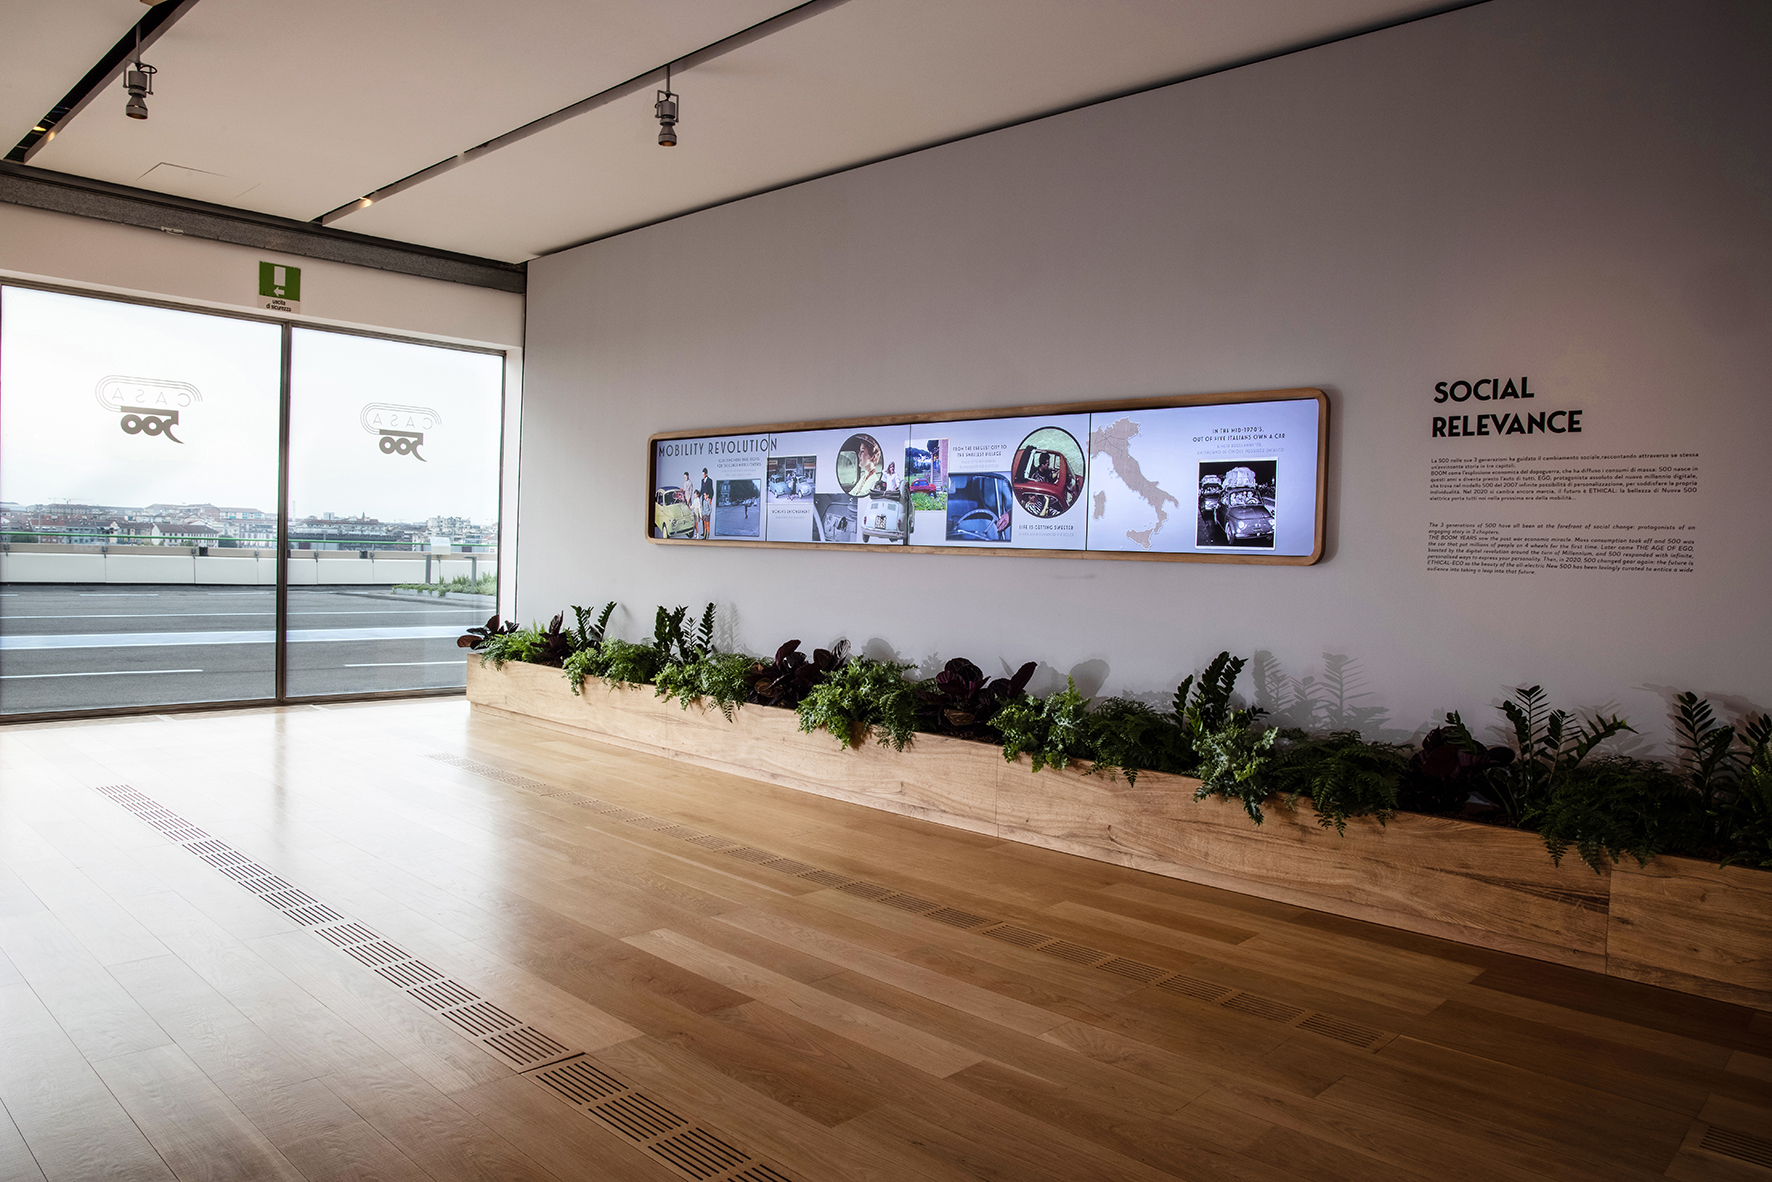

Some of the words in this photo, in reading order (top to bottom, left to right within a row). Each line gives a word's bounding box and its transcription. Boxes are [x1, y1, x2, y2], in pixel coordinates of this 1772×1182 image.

[1433, 376, 1535, 404] SOCIAL
[1432, 410, 1583, 437] RELEVANCE
[658, 442, 704, 457] MOBILITY
[708, 438, 777, 455] REVOLUTION
